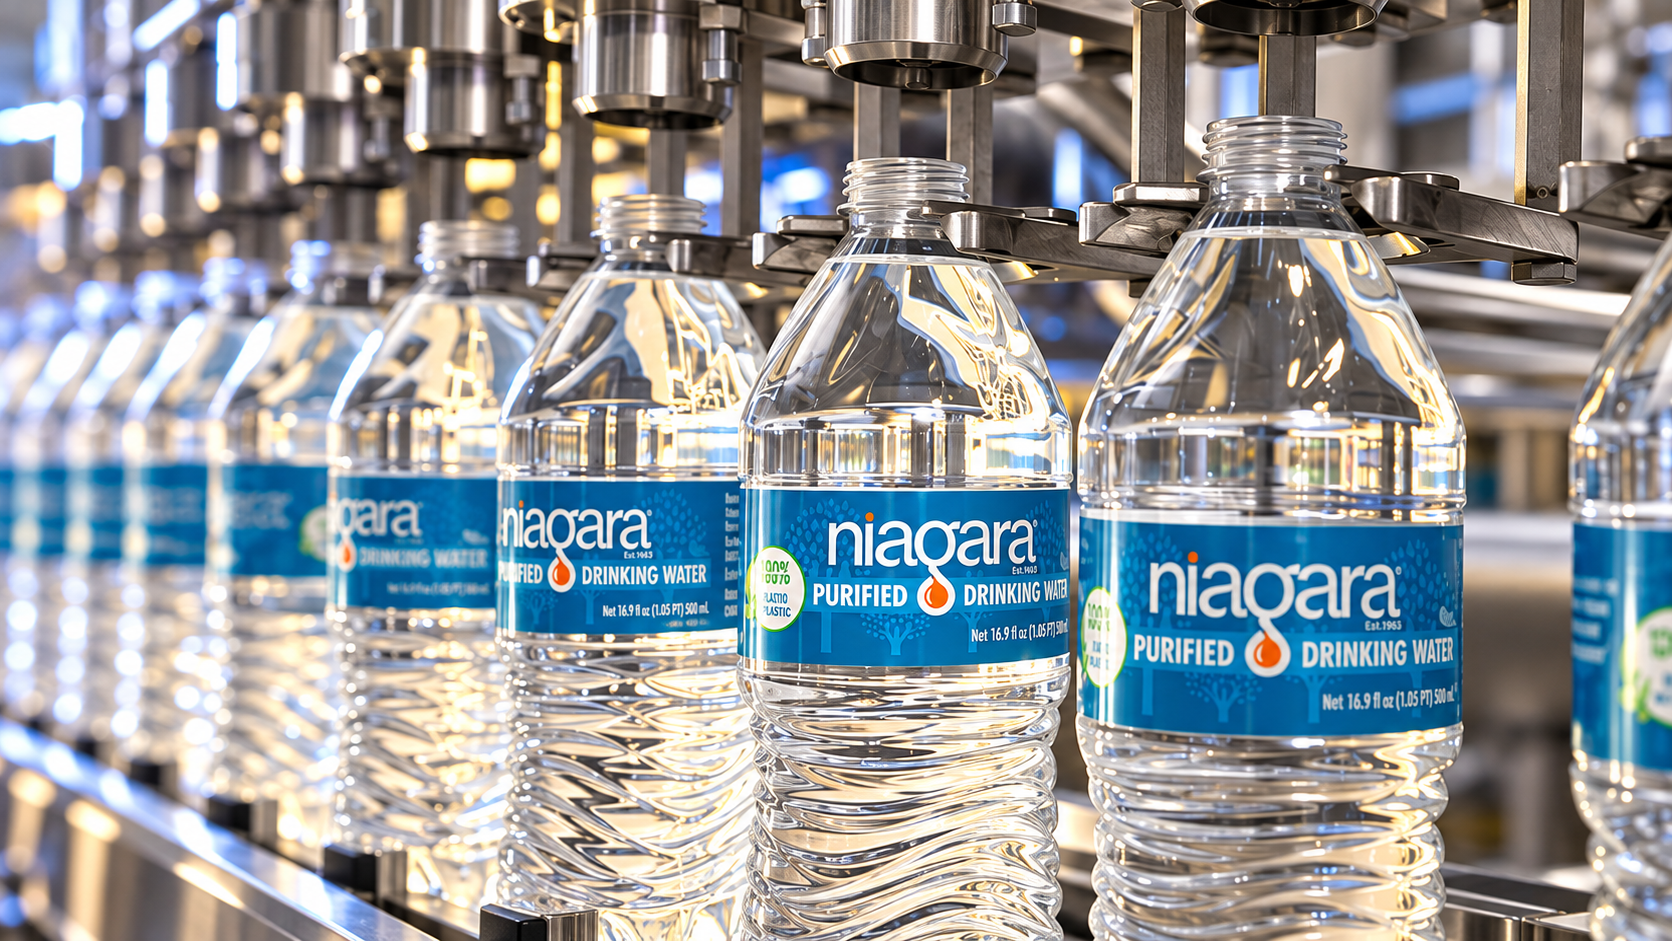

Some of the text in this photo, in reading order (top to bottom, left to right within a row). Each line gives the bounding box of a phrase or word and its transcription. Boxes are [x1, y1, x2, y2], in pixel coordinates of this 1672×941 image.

[359, 547, 488, 568] DRINKING WATER
[582, 565, 658, 585] DRINKING
[662, 564, 707, 584] WATER
[813, 583, 908, 607] PURIFIED
[964, 581, 1041, 607] DRINKING
[1044, 578, 1068, 602] WATER
[602, 604, 616, 617] Net
[617, 604, 634, 617] 16.9
[642, 607, 650, 616] oz
[685, 602, 698, 615] 500
[971, 629, 989, 642] Net
[990, 626, 1010, 642] 16.9
[1019, 628, 1028, 640] oz
[1133, 634, 1235, 667] PURIFIED
[1302, 639, 1407, 668] DRINKING
[1412, 637, 1453, 664] WATER
[1322, 693, 1344, 710] Net
[1347, 692, 1371, 710] 16.9
[1382, 695, 1395, 709] oz
[1395, 690, 1419, 711] (1.05
[1434, 687, 1447, 705] 500
